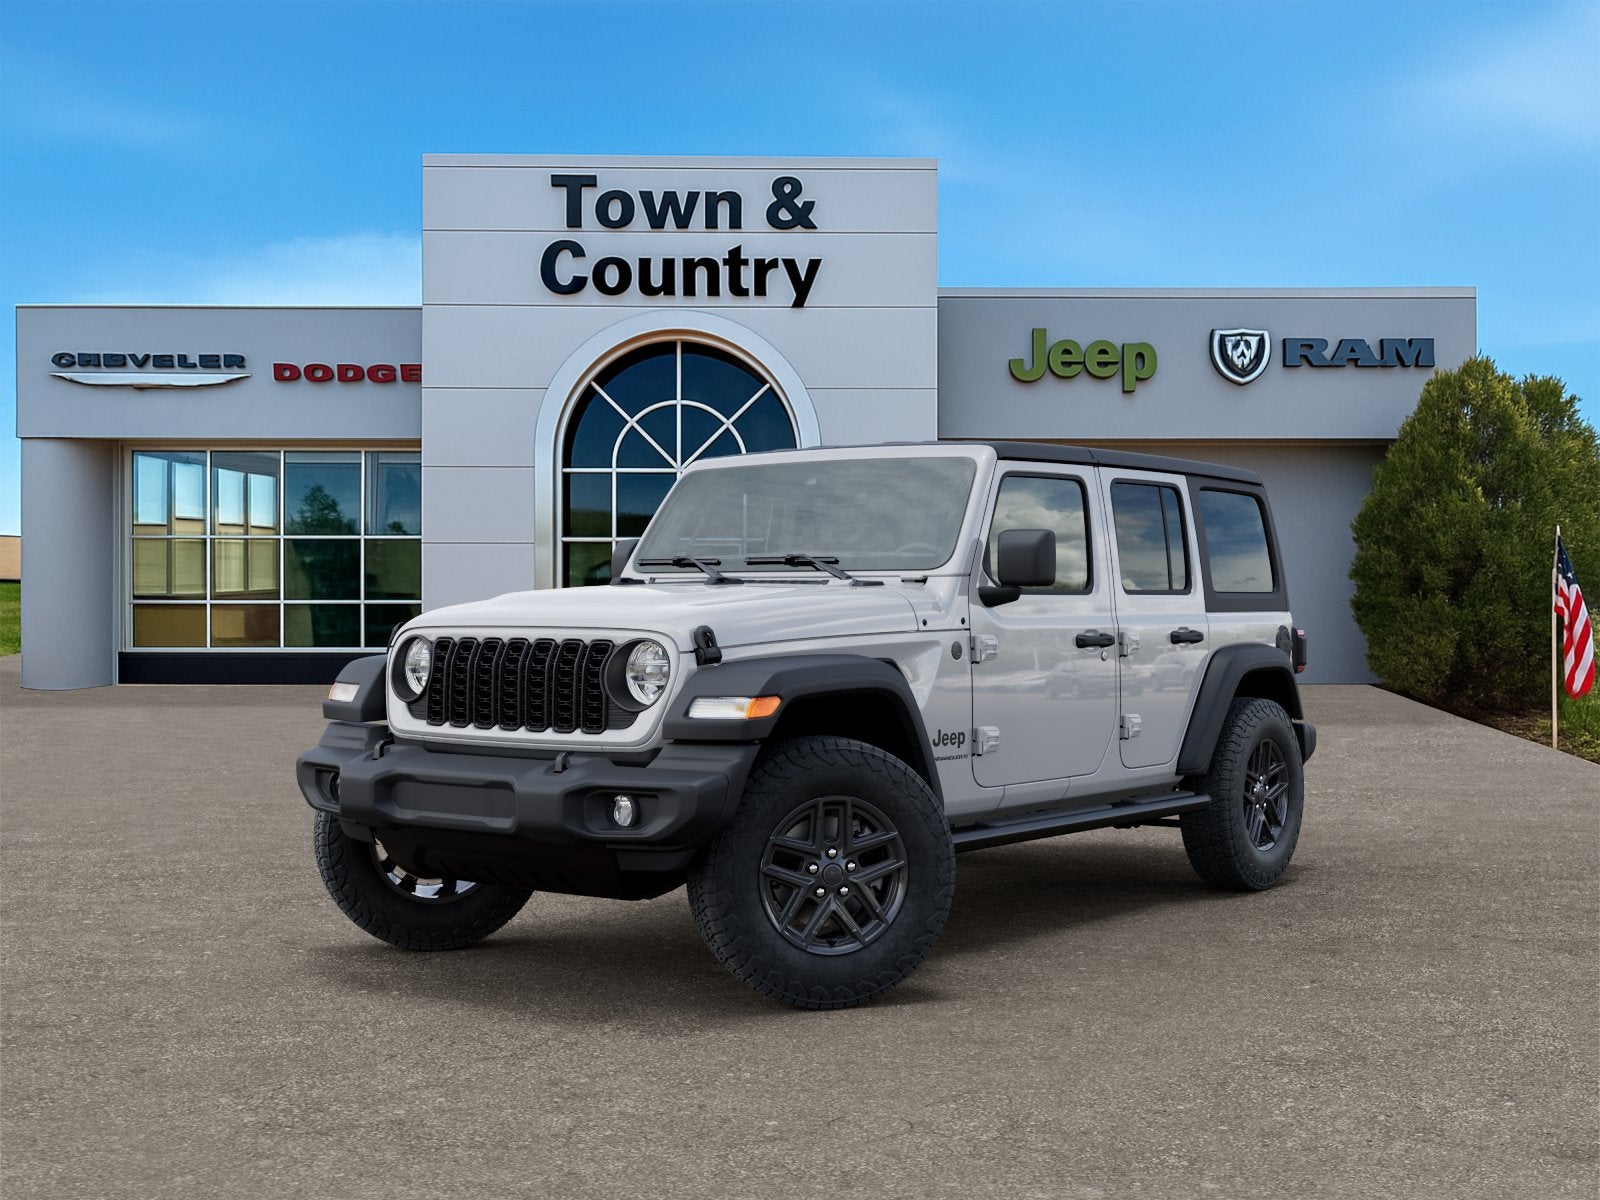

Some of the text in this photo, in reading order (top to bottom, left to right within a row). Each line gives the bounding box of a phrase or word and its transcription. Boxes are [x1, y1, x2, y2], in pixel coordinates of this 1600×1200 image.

[550, 174, 818, 230] Town &
[540, 239, 822, 308] Country
[273, 362, 422, 382] DODGE
[1008, 328, 1158, 392] Jeep
[1282, 337, 1436, 368] RAM
[932, 729, 965, 748] Jeep
